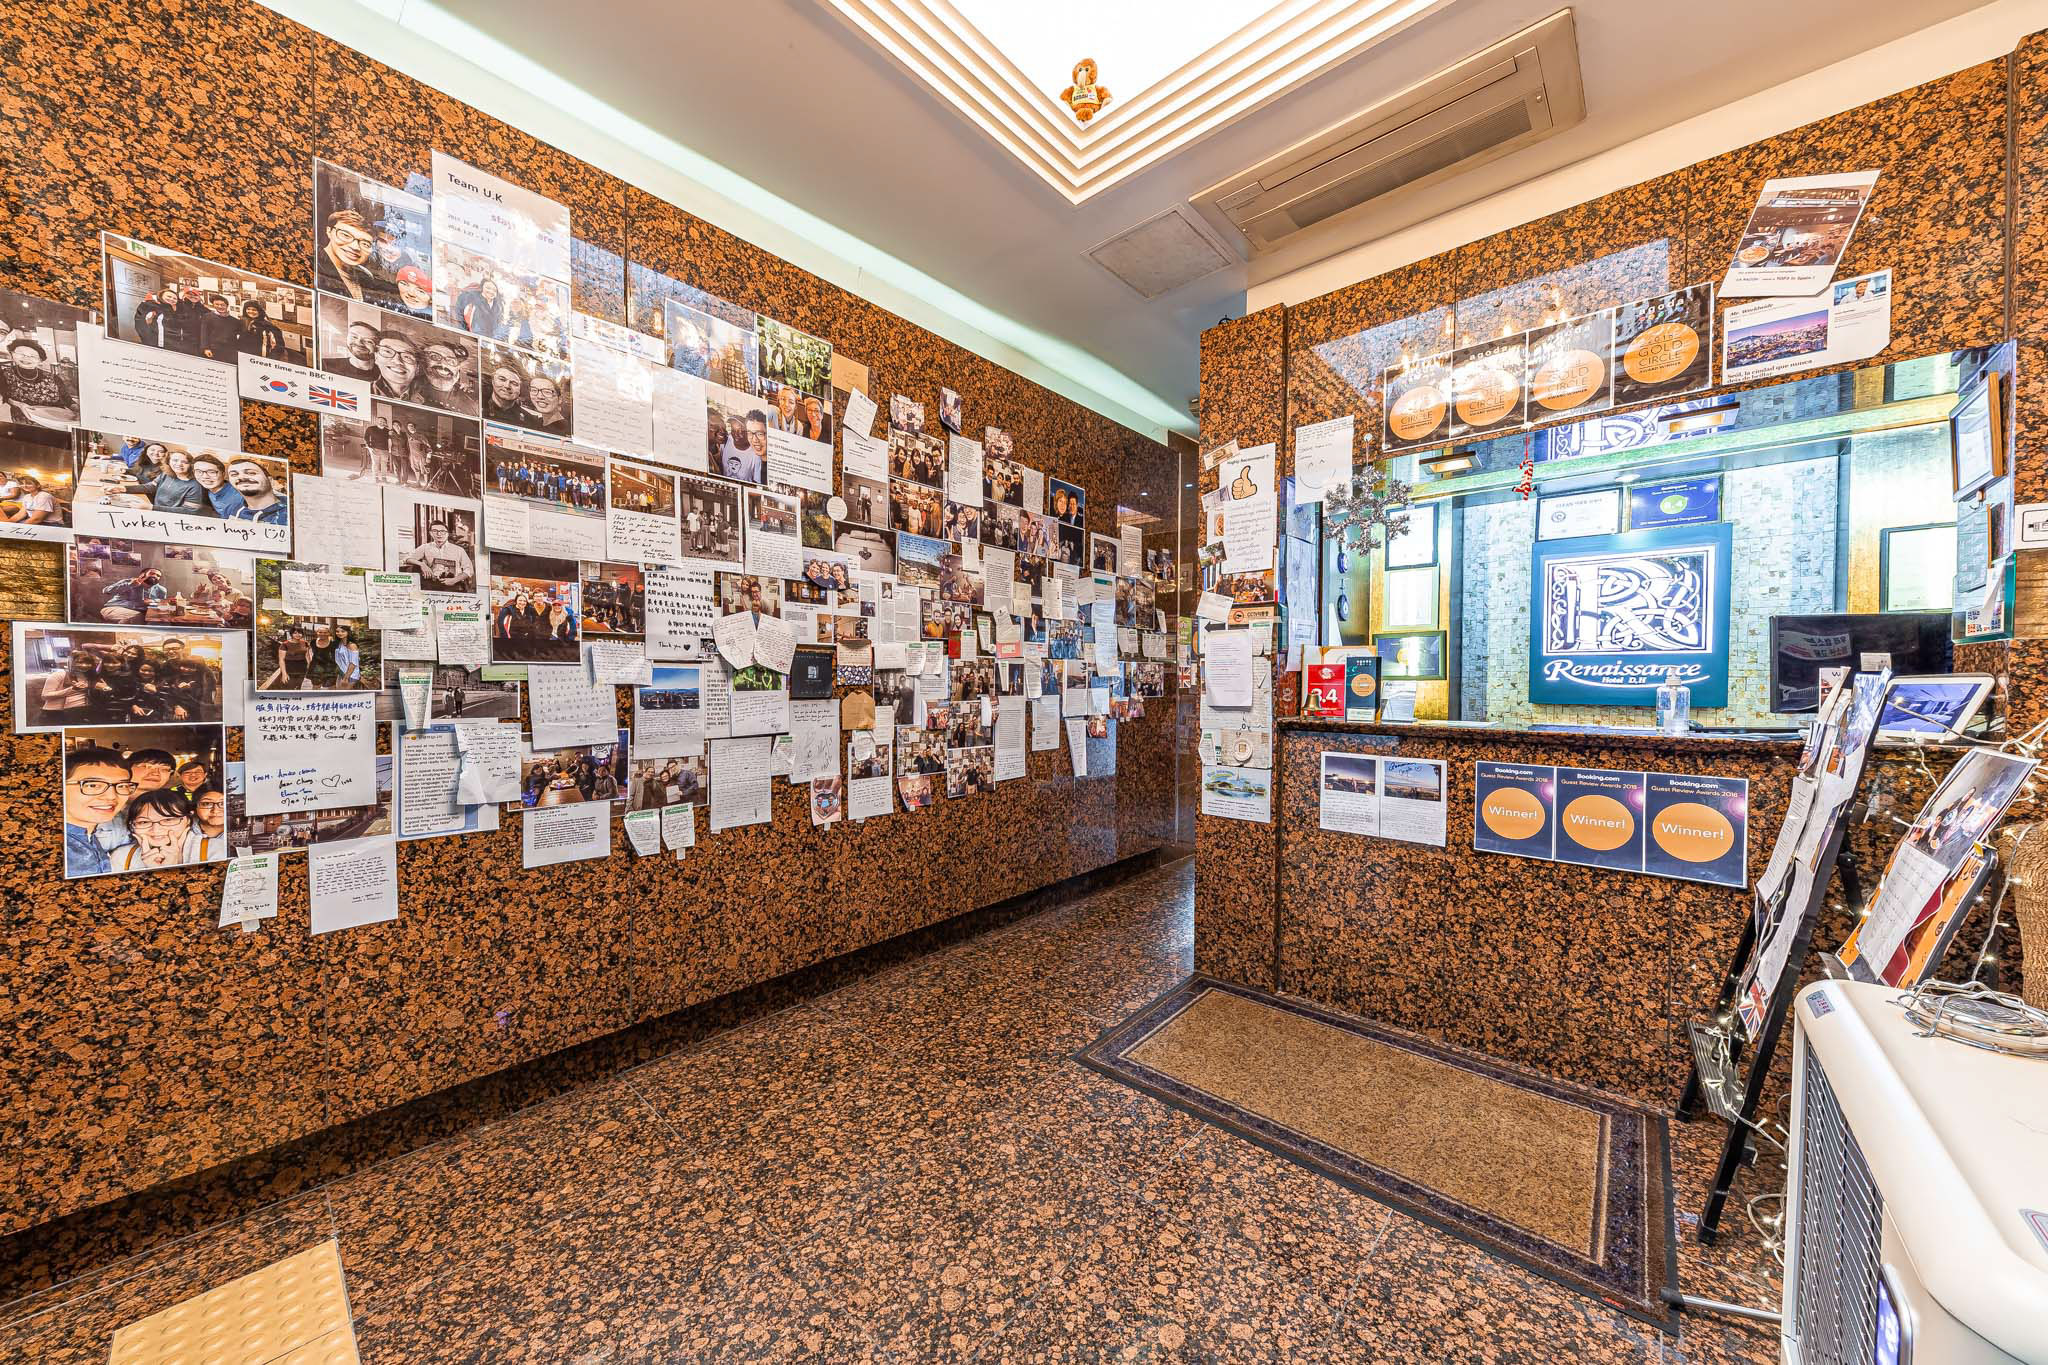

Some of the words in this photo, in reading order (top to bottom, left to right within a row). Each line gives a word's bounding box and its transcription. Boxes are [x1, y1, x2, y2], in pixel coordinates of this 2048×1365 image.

[447, 172, 479, 193] Team
[483, 188, 503, 204] U.K
[1639, 298, 1684, 316] agoda
[1469, 345, 1509, 361] agoda
[1638, 339, 1684, 357] GOLD
[1639, 351, 1682, 368] CIRCLE
[249, 358, 272, 369] Great
[274, 363, 293, 373] time
[309, 371, 326, 380] BBC
[1400, 410, 1433, 425] CIRCLE
[97, 511, 170, 537] Turkey
[174, 519, 217, 532] team
[224, 522, 256, 541] hugs
[1543, 658, 1702, 681] Renaissance
[1602, 676, 1624, 684] Hotel
[1494, 767, 1533, 775] Booking.com
[1576, 773, 1620, 782] Booking.com
[1669, 779, 1719, 789] Booking.com
[1696, 789, 1721, 797] Awards
[1488, 804, 1537, 820] Winner!
[1570, 814, 1625, 829] Winner!
[1661, 822, 1724, 840] Winner!
